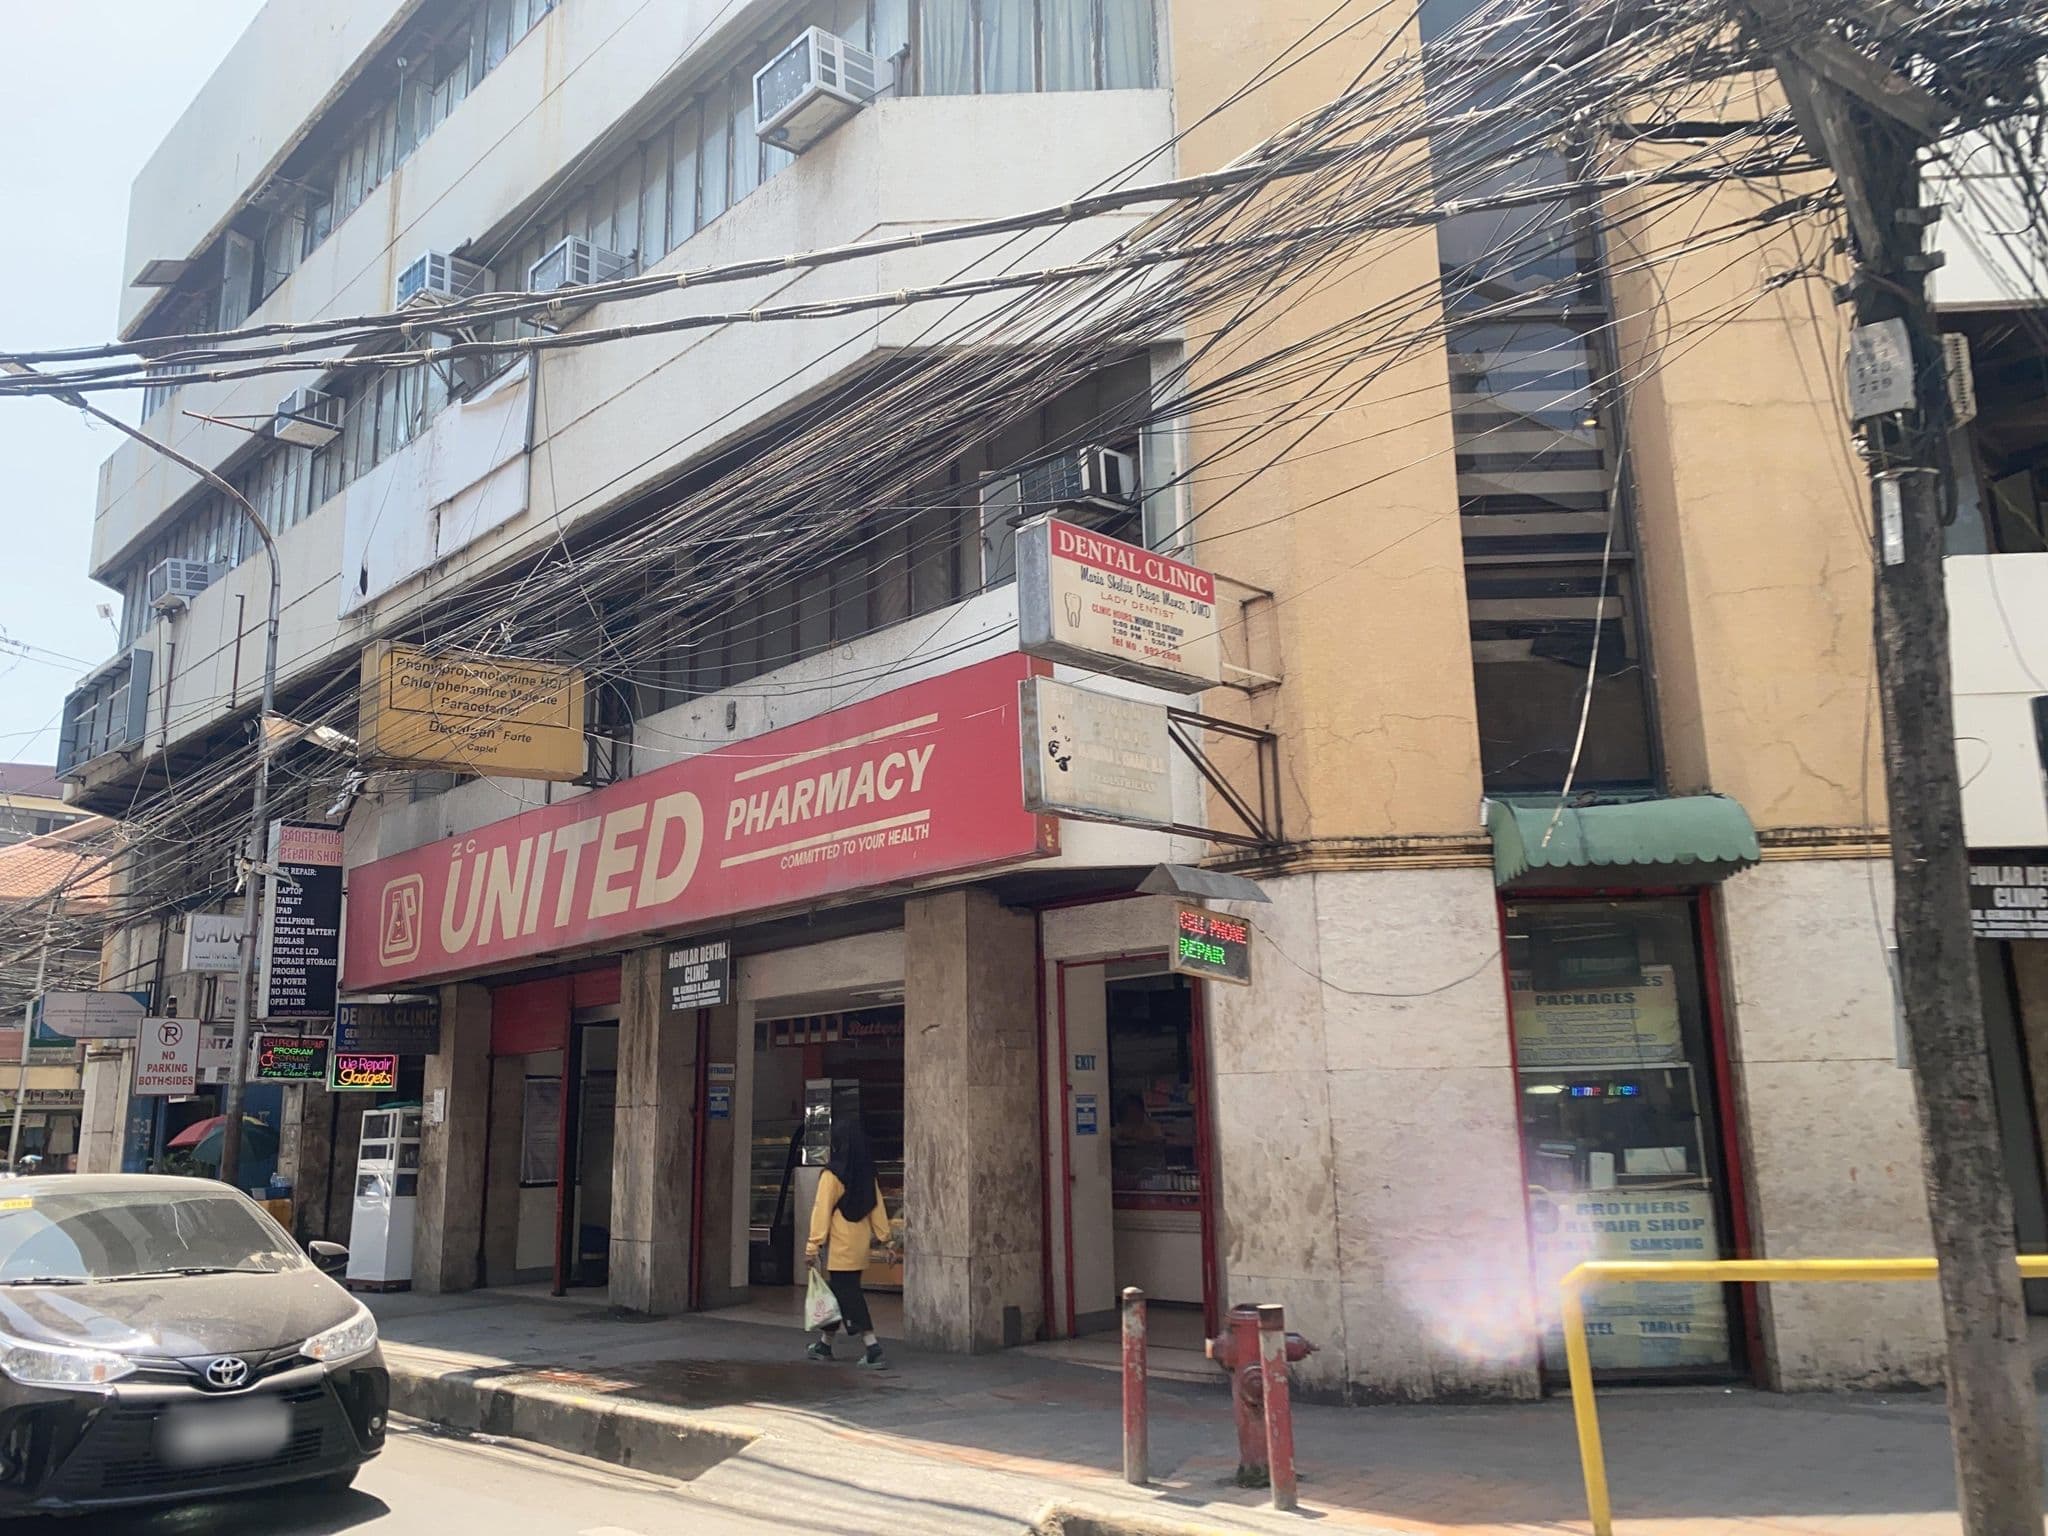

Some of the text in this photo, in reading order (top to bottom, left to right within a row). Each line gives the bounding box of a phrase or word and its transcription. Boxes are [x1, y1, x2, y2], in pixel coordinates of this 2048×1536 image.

[1059, 529, 1209, 597] DENTAL CLINIC
[1101, 592, 1176, 620] LADY DENTIST
[1111, 635, 1124, 648] Tel
[503, 730, 533, 744] Forte
[466, 743, 498, 754] Caplet
[724, 744, 937, 842] PHARMACY
[281, 829, 341, 845] GADGET HUB
[780, 822, 930, 870] COMMITTED TO YOUR HEALTH
[280, 847, 343, 863] REPAIR SHOP
[291, 867, 317, 876] REPAIR:
[439, 790, 705, 954] UNITED
[277, 886, 303, 895] LAPTOP
[277, 896, 302, 905] TABLET
[1993, 887, 2048, 908] CLINIC
[276, 906, 292, 914] IPAD
[275, 916, 315, 925] CELLPHONE
[275, 927, 337, 936] REPLACE BATTERY
[1179, 911, 1248, 945] CELL PHONE
[274, 937, 305, 945] REGLASS
[273, 947, 303, 955] REPLACE
[668, 941, 727, 969] AGUILAR DENTAL
[1179, 937, 1226, 966] REPAIR
[273, 957, 337, 966] UPGRADE STORAGE
[272, 967, 306, 975] PROGRAM
[684, 963, 709, 984] CLINIC
[282, 988, 307, 996] SIGNAL
[270, 998, 306, 1006] OPEN LINE
[1535, 992, 1636, 1007] PACKAGES
[161, 1051, 176, 1061] NO
[273, 1047, 314, 1056] PROGRAM
[146, 1063, 188, 1073] PARKING
[339, 1057, 391, 1073] We Repair
[1075, 1055, 1097, 1071] EXIT
[138, 1075, 194, 1086] BOTH SIDES
[1576, 1200, 1690, 1215] BROTHERS
[1647, 1218, 1705, 1232] SHOP
[1629, 1238, 1705, 1251] SAMSUNG
